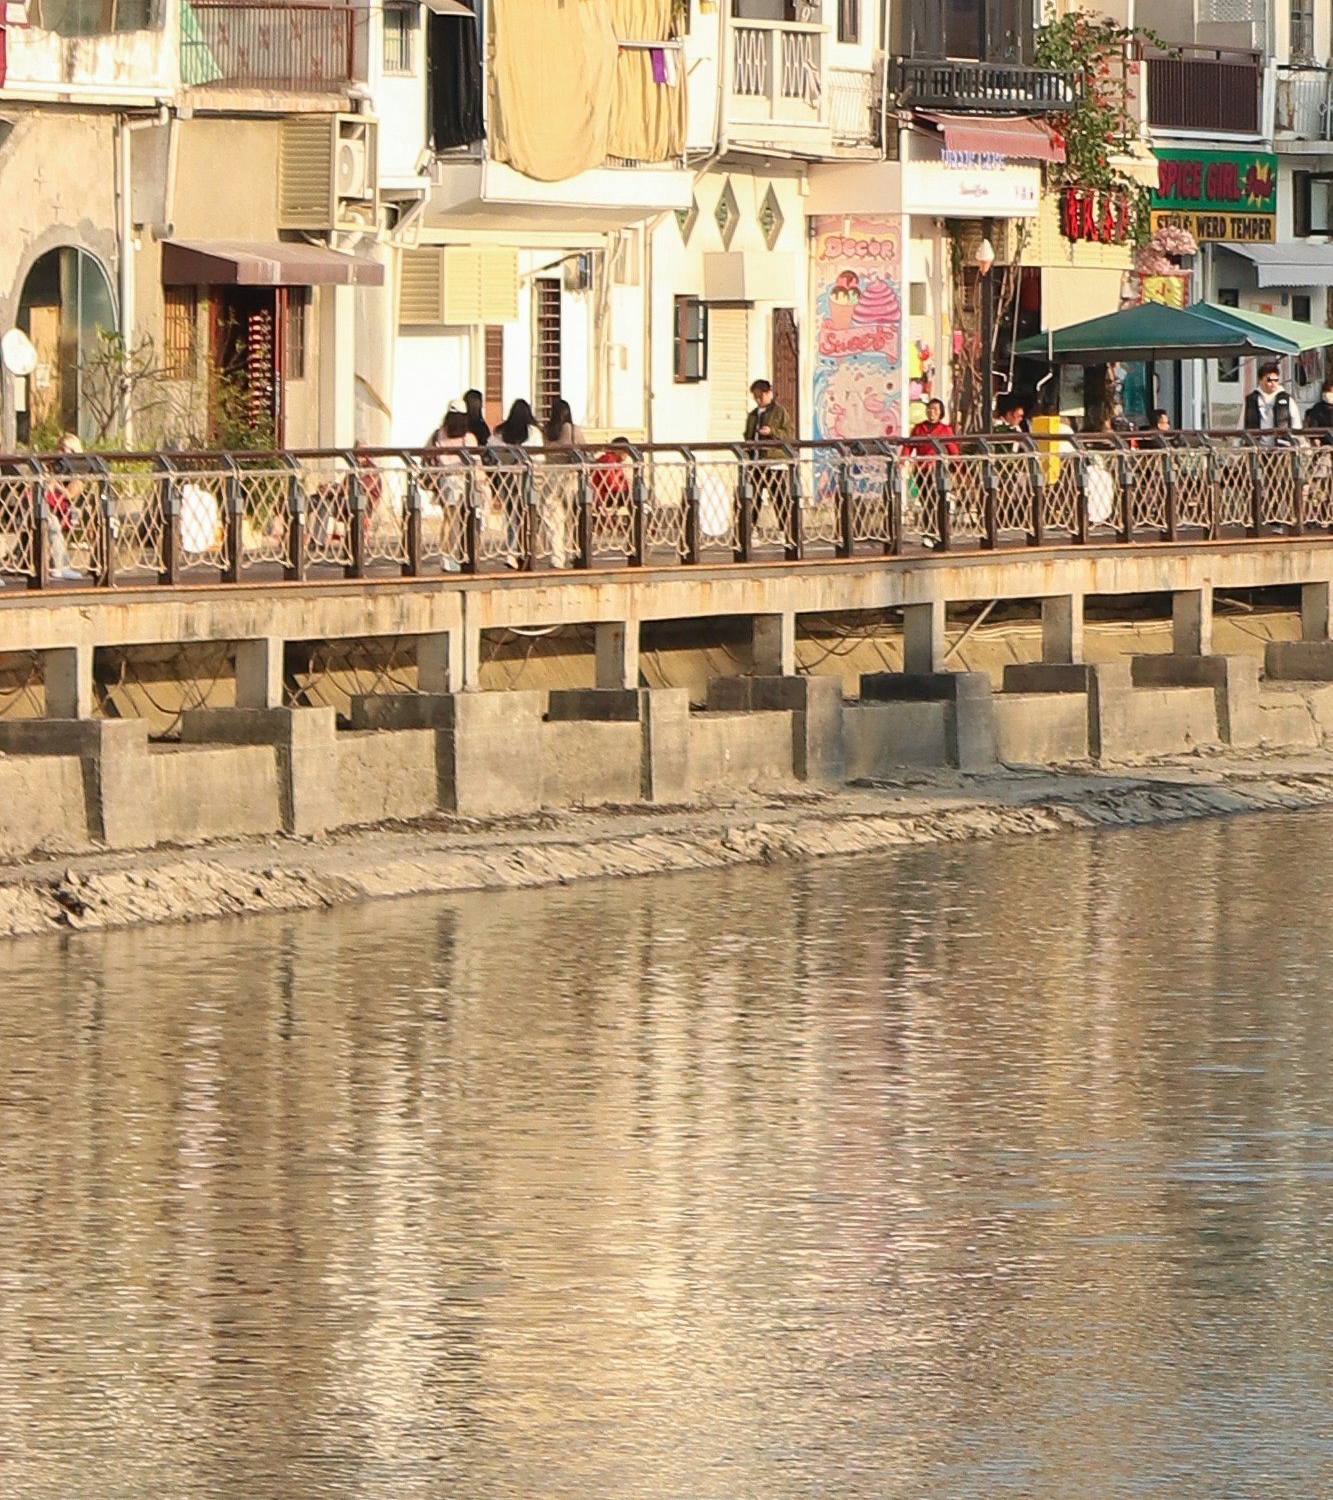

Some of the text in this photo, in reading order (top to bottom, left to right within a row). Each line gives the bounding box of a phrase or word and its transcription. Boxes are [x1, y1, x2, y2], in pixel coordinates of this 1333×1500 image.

[1157, 159, 1203, 198] SPICE
[1206, 162, 1241, 201] GIRL
[1230, 218, 1271, 240] TEMPER
